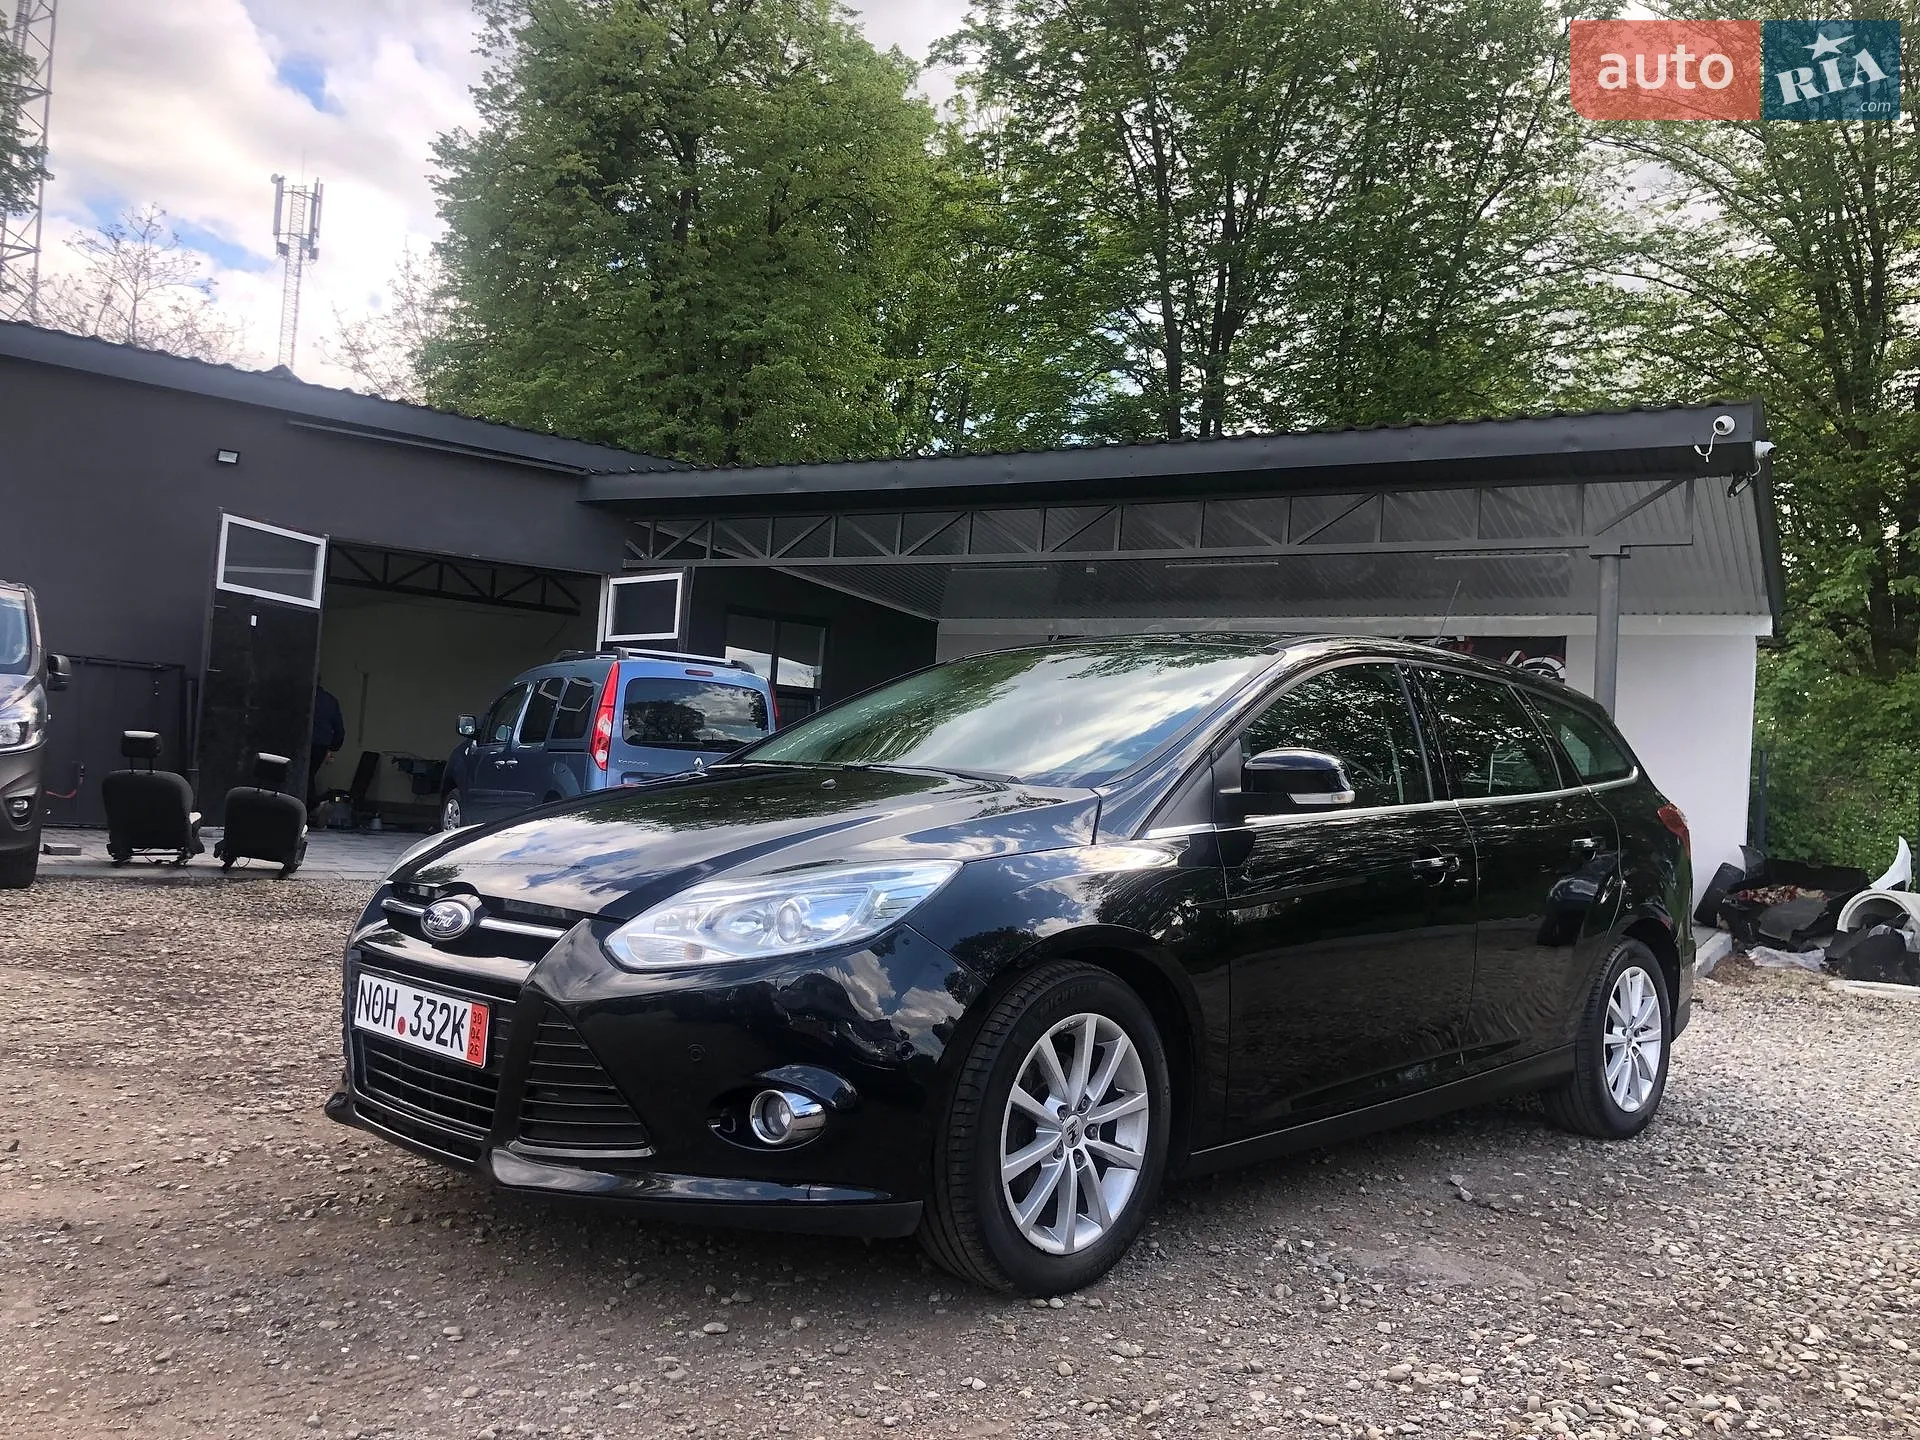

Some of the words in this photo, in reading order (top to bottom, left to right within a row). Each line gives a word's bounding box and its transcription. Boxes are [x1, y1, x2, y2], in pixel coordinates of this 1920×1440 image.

[427, 905, 457, 928] Ford
[357, 979, 398, 1030] NOH
[409, 994, 468, 1052] 332K
[472, 1011, 483, 1025] 30
